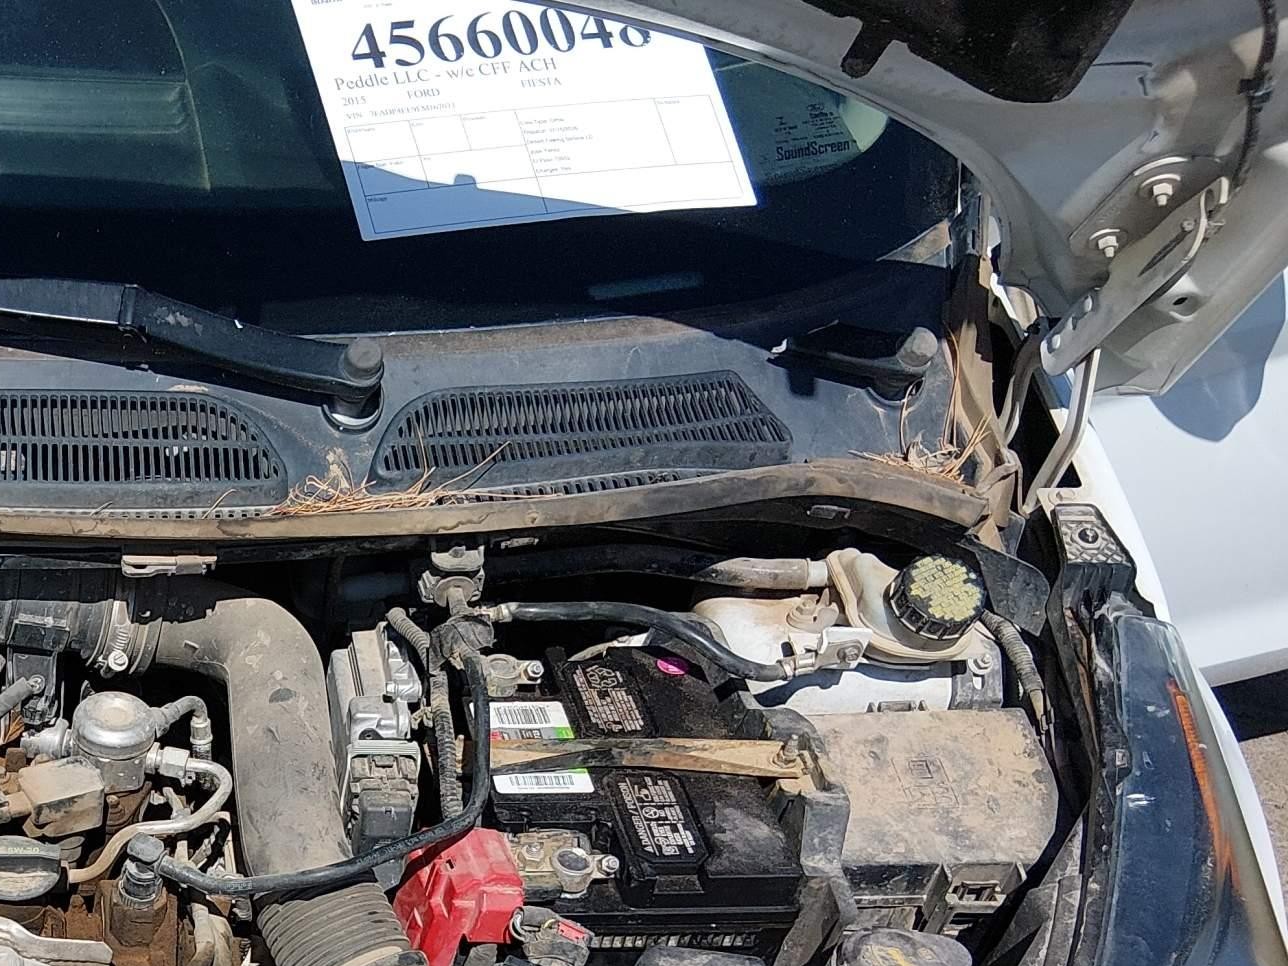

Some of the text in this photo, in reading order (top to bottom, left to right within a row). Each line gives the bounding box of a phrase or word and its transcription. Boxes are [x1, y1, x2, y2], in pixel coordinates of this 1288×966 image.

[334, 73, 389, 91] Peddle
[393, 69, 430, 84] LLC
[478, 60, 511, 76] CFF
[519, 57, 557, 72] ACH
[342, 77, 562, 106] 2015 FORD FIESTA
[775, 140, 850, 161] SoundScreen
[632, 815, 651, 846] DANGER
